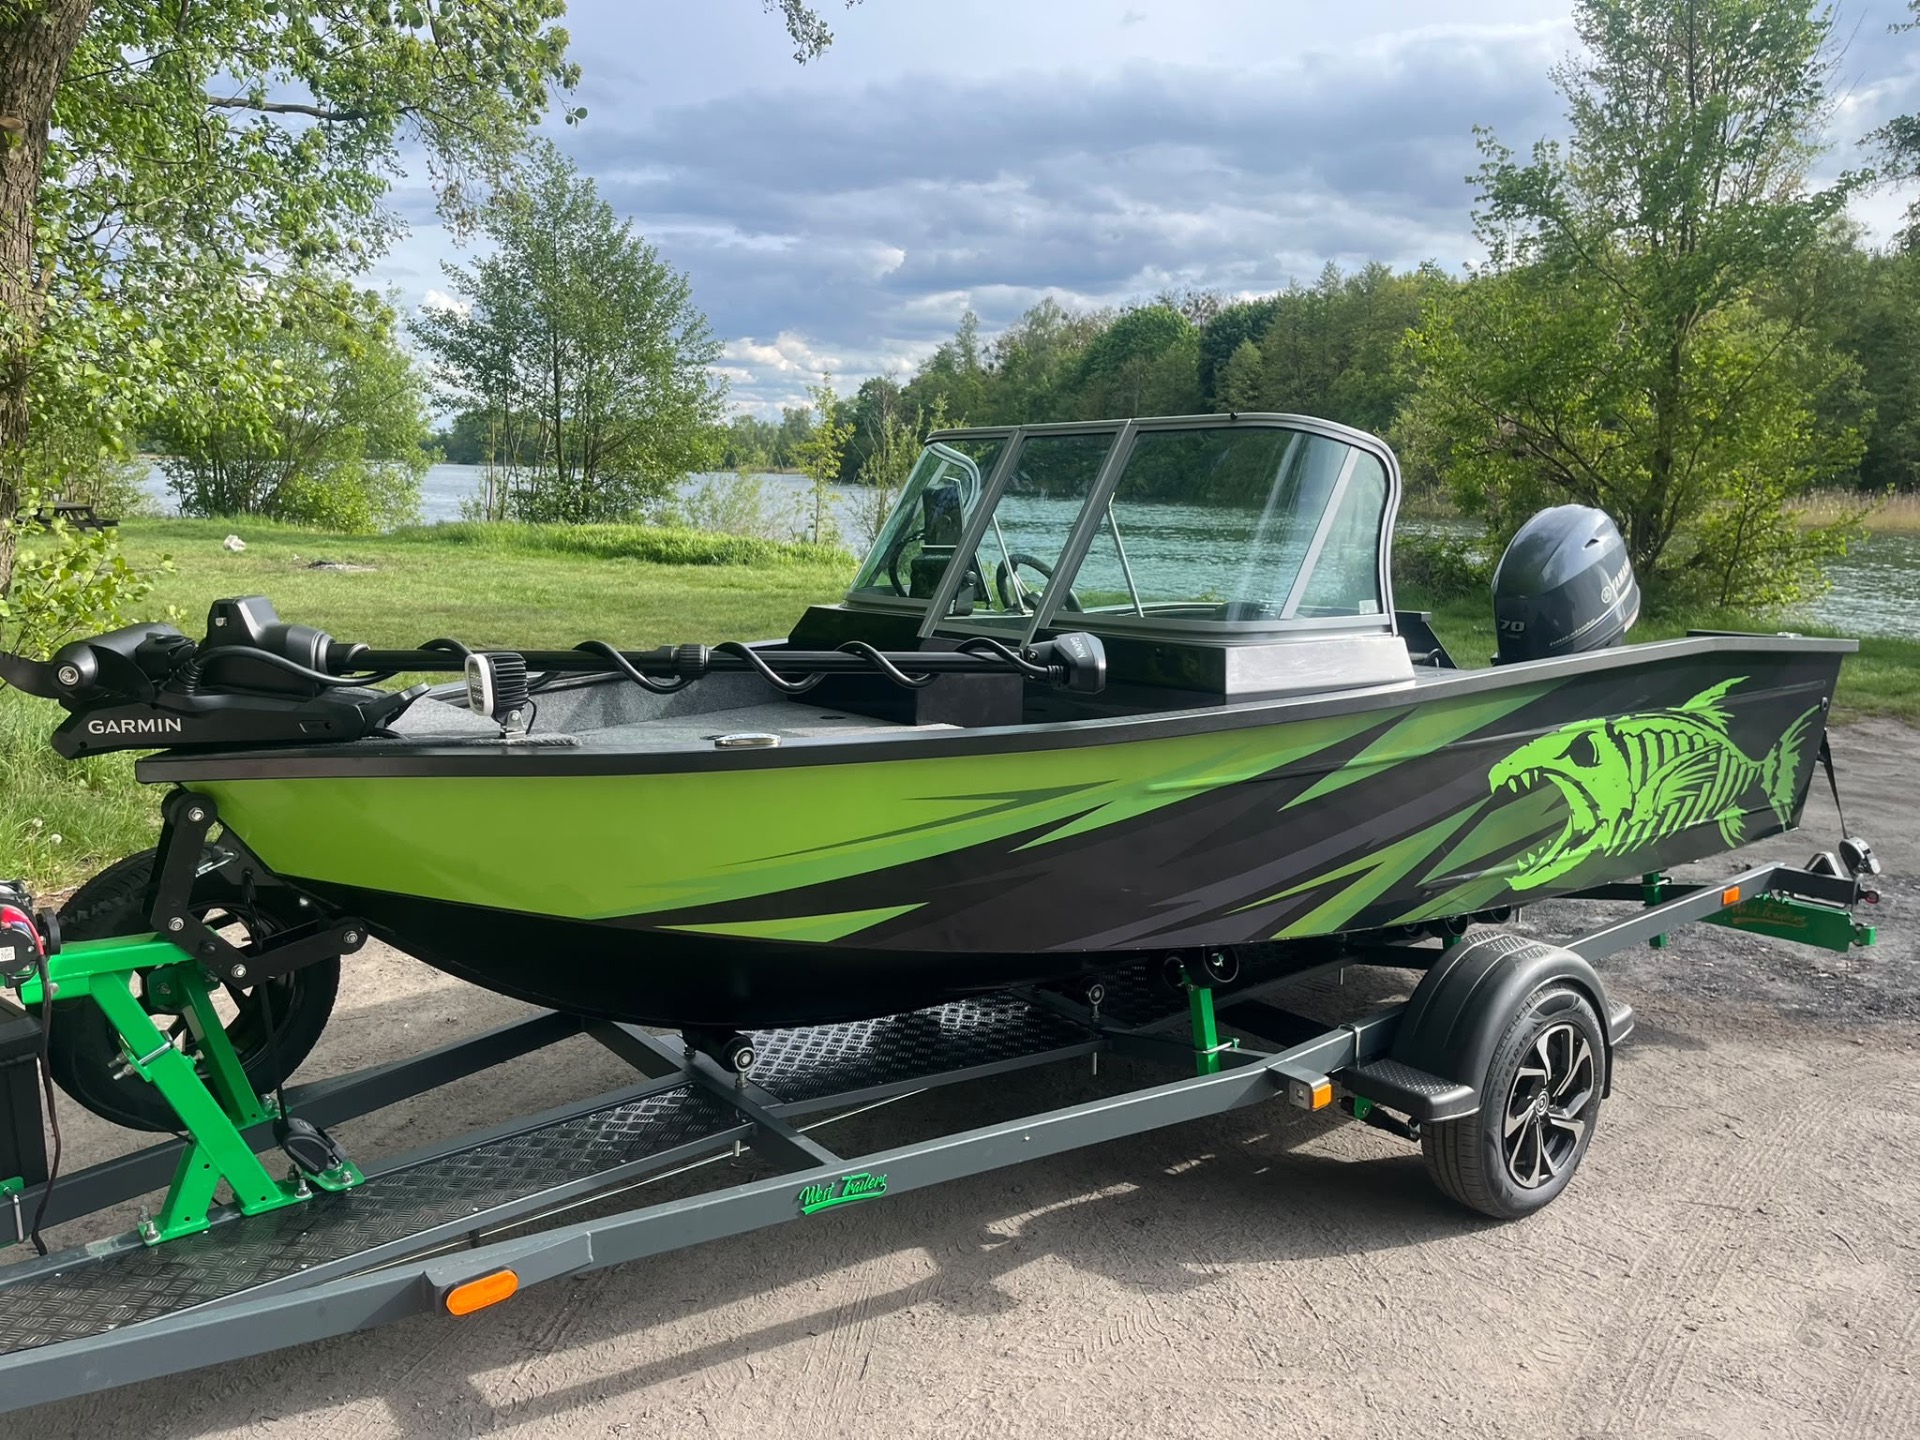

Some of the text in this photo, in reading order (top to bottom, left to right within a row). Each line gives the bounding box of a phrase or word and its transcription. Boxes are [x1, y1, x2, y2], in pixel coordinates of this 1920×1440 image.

[1500, 619, 1525, 632] 70
[88, 718, 182, 734] GARMIN
[799, 1172, 887, 1205] West Trailers
